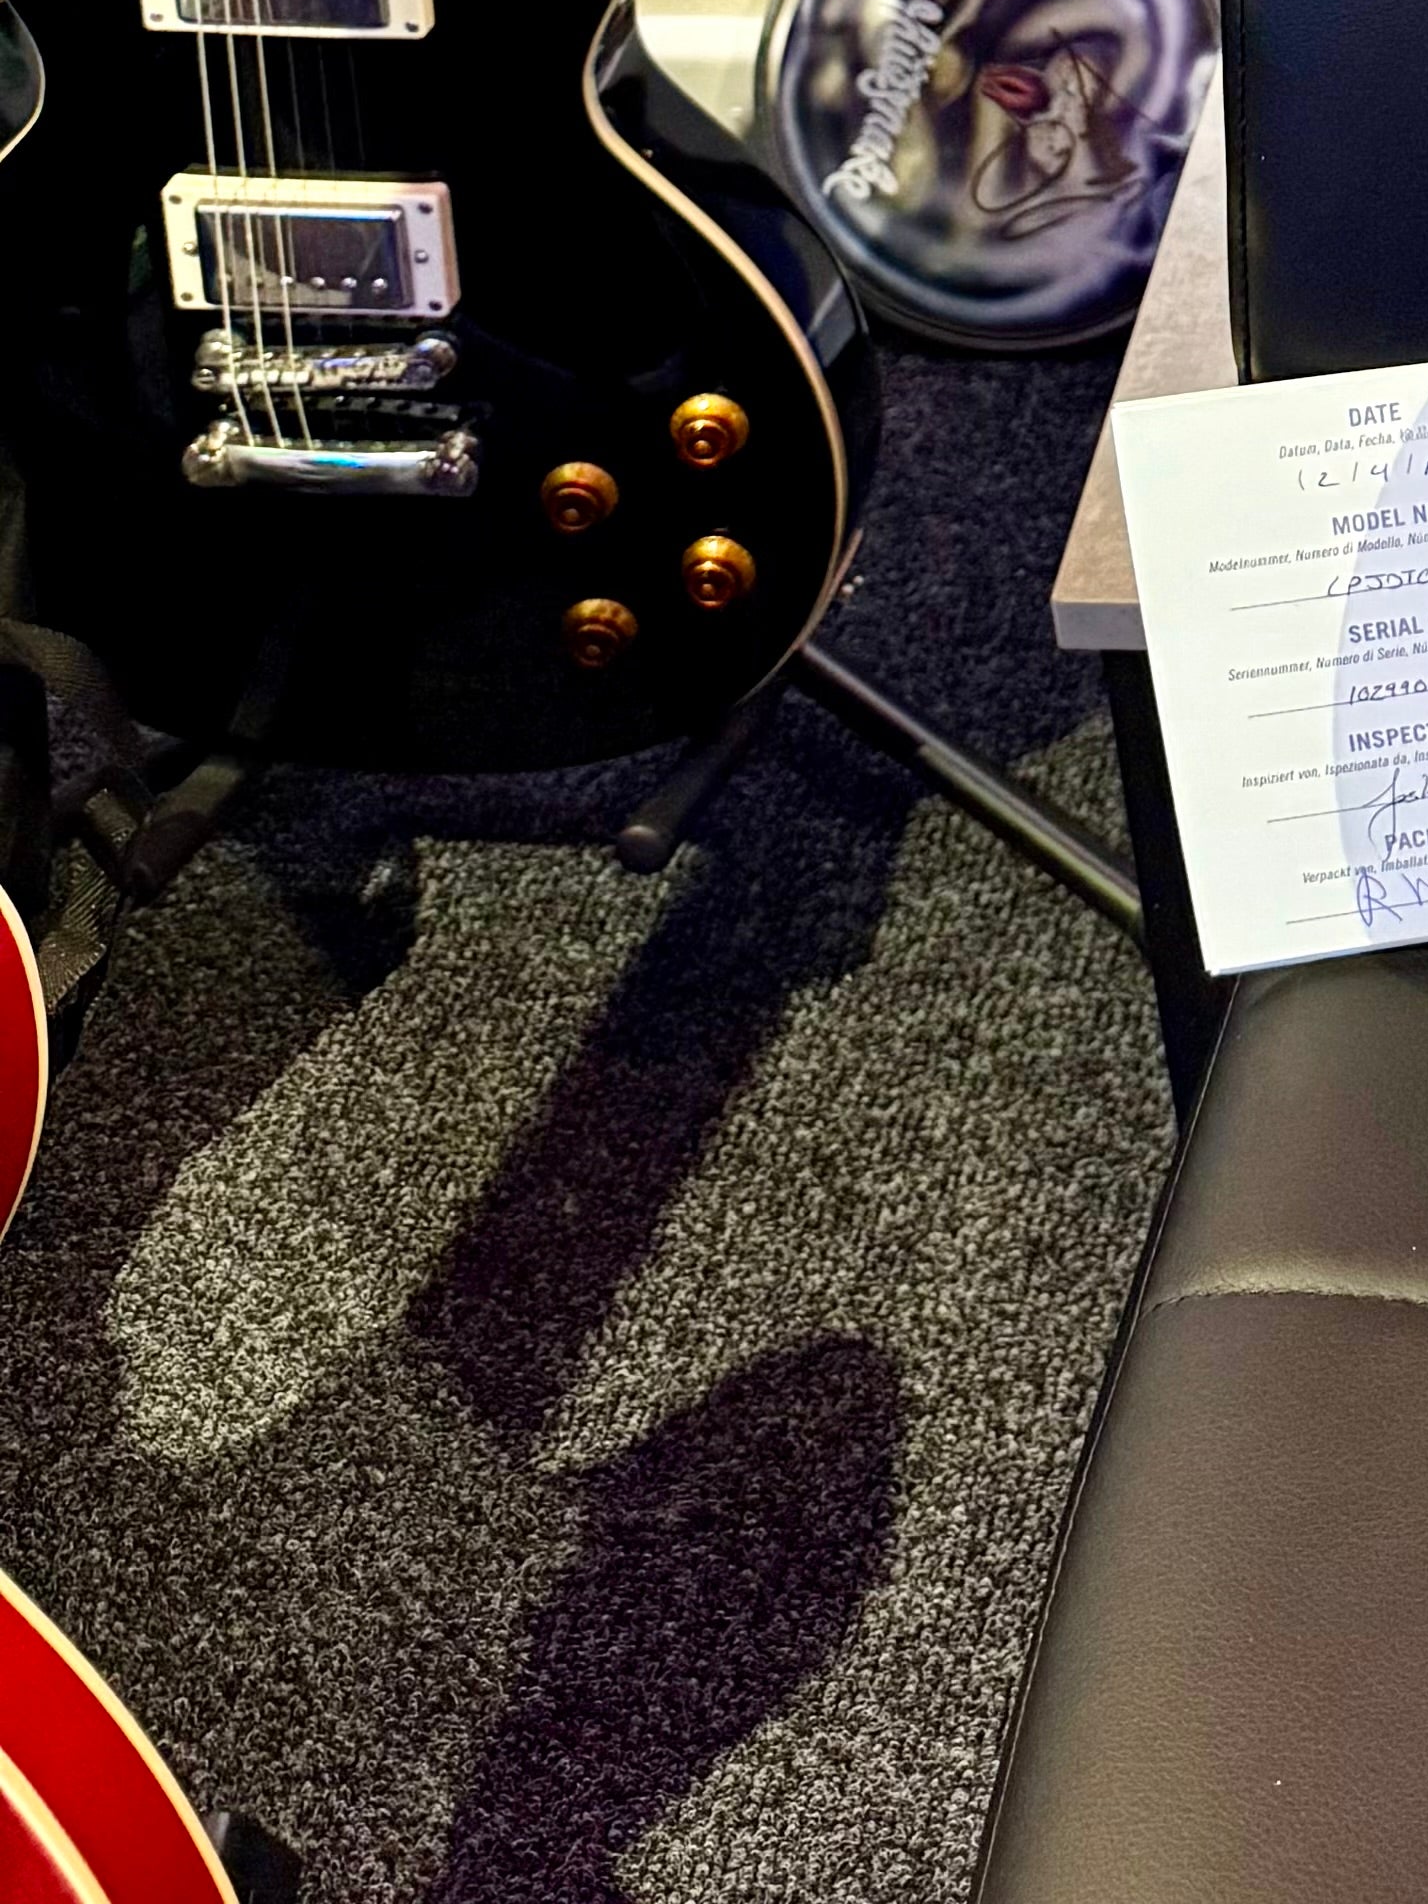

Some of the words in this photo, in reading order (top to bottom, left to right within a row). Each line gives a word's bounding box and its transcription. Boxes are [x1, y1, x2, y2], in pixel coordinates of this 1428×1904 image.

[1349, 402, 1402, 427] DATE
[1359, 433, 1396, 449] Fecha,
[1332, 509, 1406, 536] MODEL
[1296, 545, 1340, 562] Numero
[1343, 544, 1354, 556] di
[1357, 537, 1404, 553] Modello,
[1348, 616, 1424, 644] SERIAL
[1228, 660, 1313, 681] Seriennummer,
[1316, 652, 1360, 669] Numero
[1362, 649, 1374, 661] di
[1377, 645, 1409, 661] Serie,
[1298, 767, 1321, 780] von,
[1325, 754, 1390, 777] Ispezionata
[1393, 751, 1411, 766] da,
[1302, 866, 1350, 884] Verpackt
